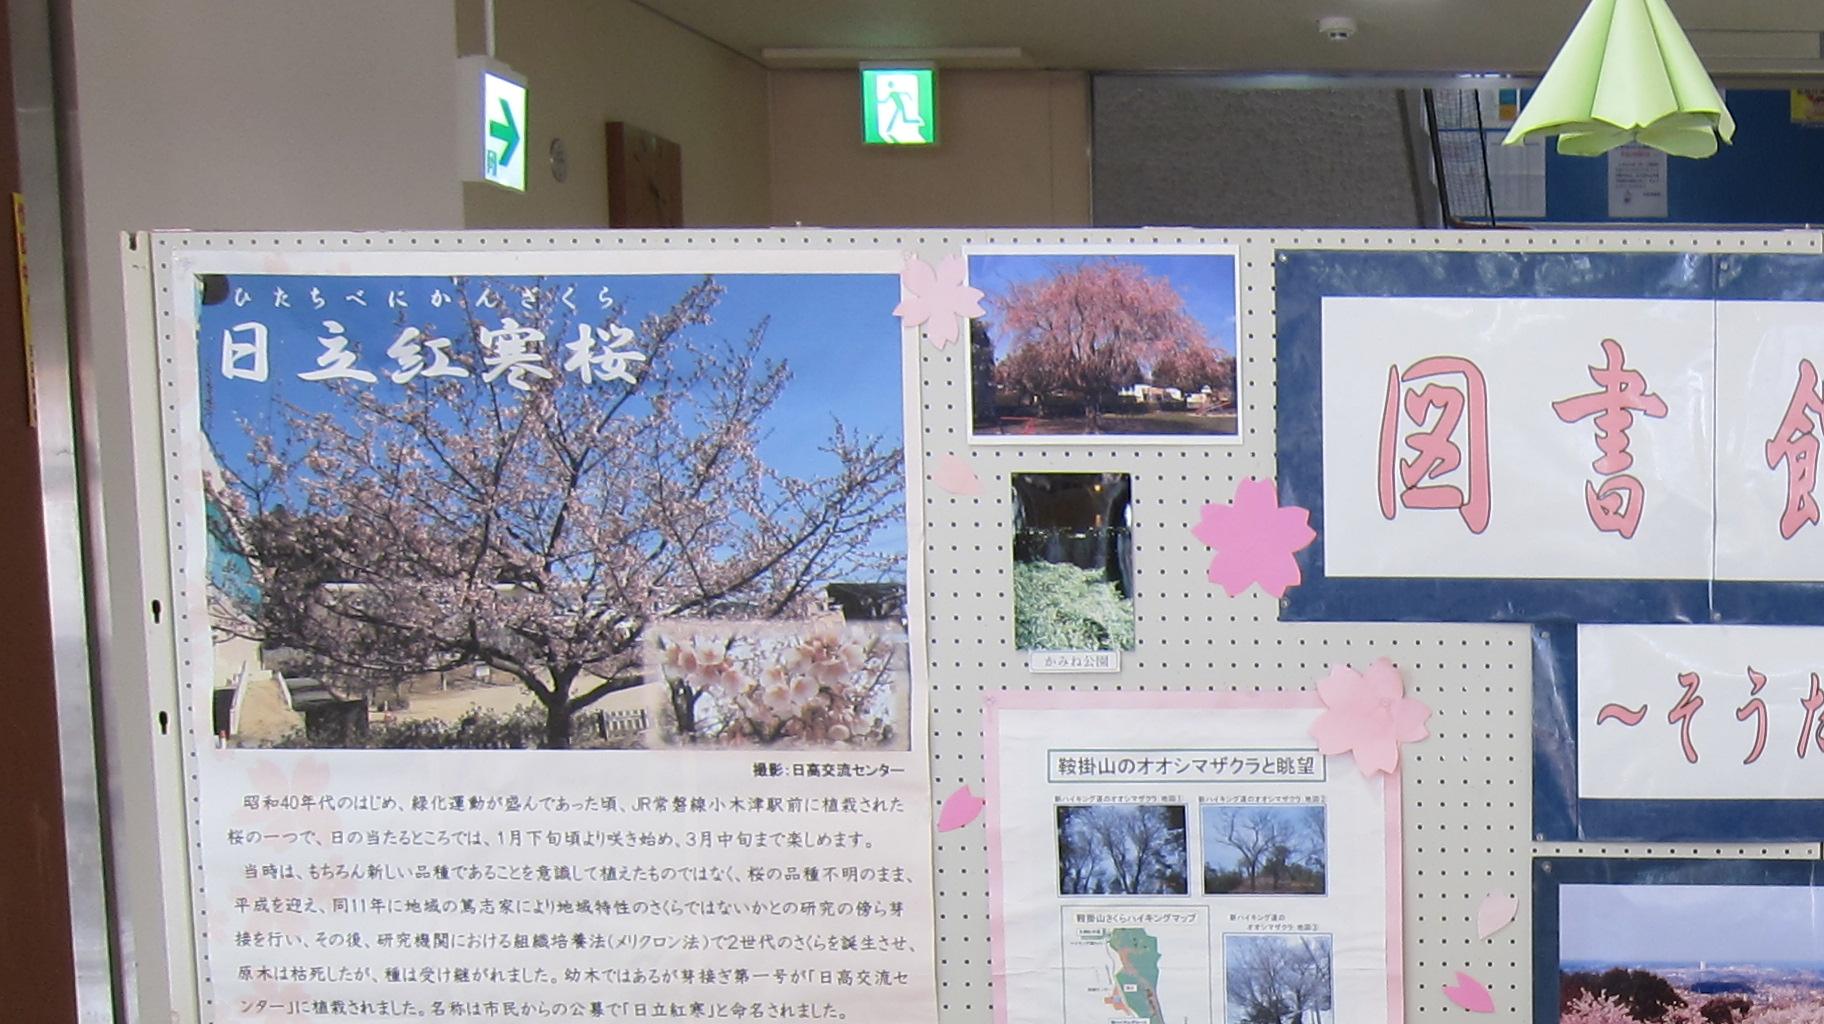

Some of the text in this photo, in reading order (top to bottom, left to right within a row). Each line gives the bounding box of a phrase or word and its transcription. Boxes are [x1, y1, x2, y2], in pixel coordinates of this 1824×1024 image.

[235, 287, 613, 309] ひたちべにかんざくら
[221, 317, 647, 391] 日立紅寒桜
[1045, 655, 1109, 668] かみね公園
[1058, 755, 1315, 777] 鞍掛山のオオシマザクラと眺望
